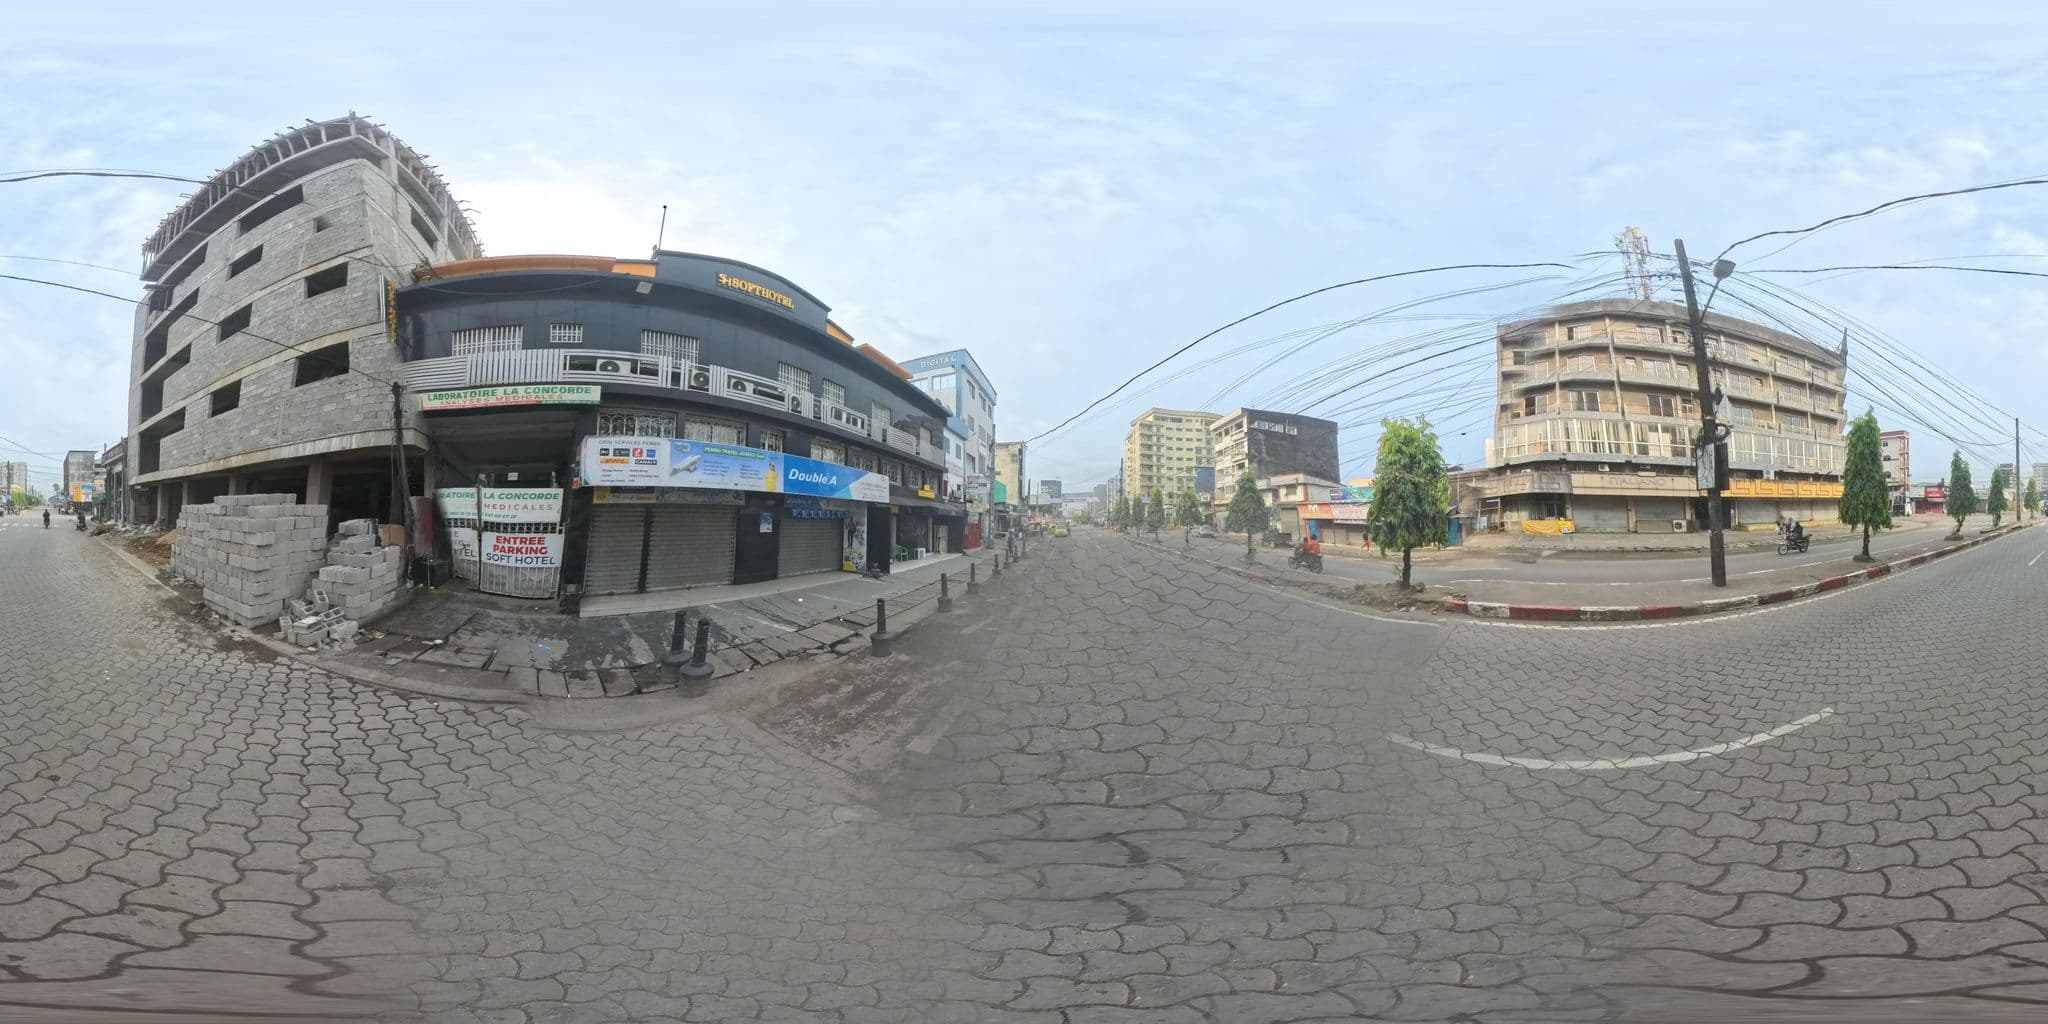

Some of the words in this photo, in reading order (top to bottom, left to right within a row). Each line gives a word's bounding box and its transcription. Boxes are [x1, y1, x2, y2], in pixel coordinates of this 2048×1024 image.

[920, 355, 956, 368] DIGITAL
[427, 389, 498, 401] LABORATOIRE
[503, 387, 519, 395] LA
[524, 386, 592, 394] CONCORDE
[788, 468, 828, 485] Double
[828, 475, 838, 486] A
[498, 492, 559, 500] CONCORDE
[484, 503, 553, 511] MEDICALES
[496, 535, 546, 546] ENTREE
[493, 544, 548, 555] PARKING
[486, 553, 511, 564] SOFT
[515, 555, 556, 565] HOTEL
